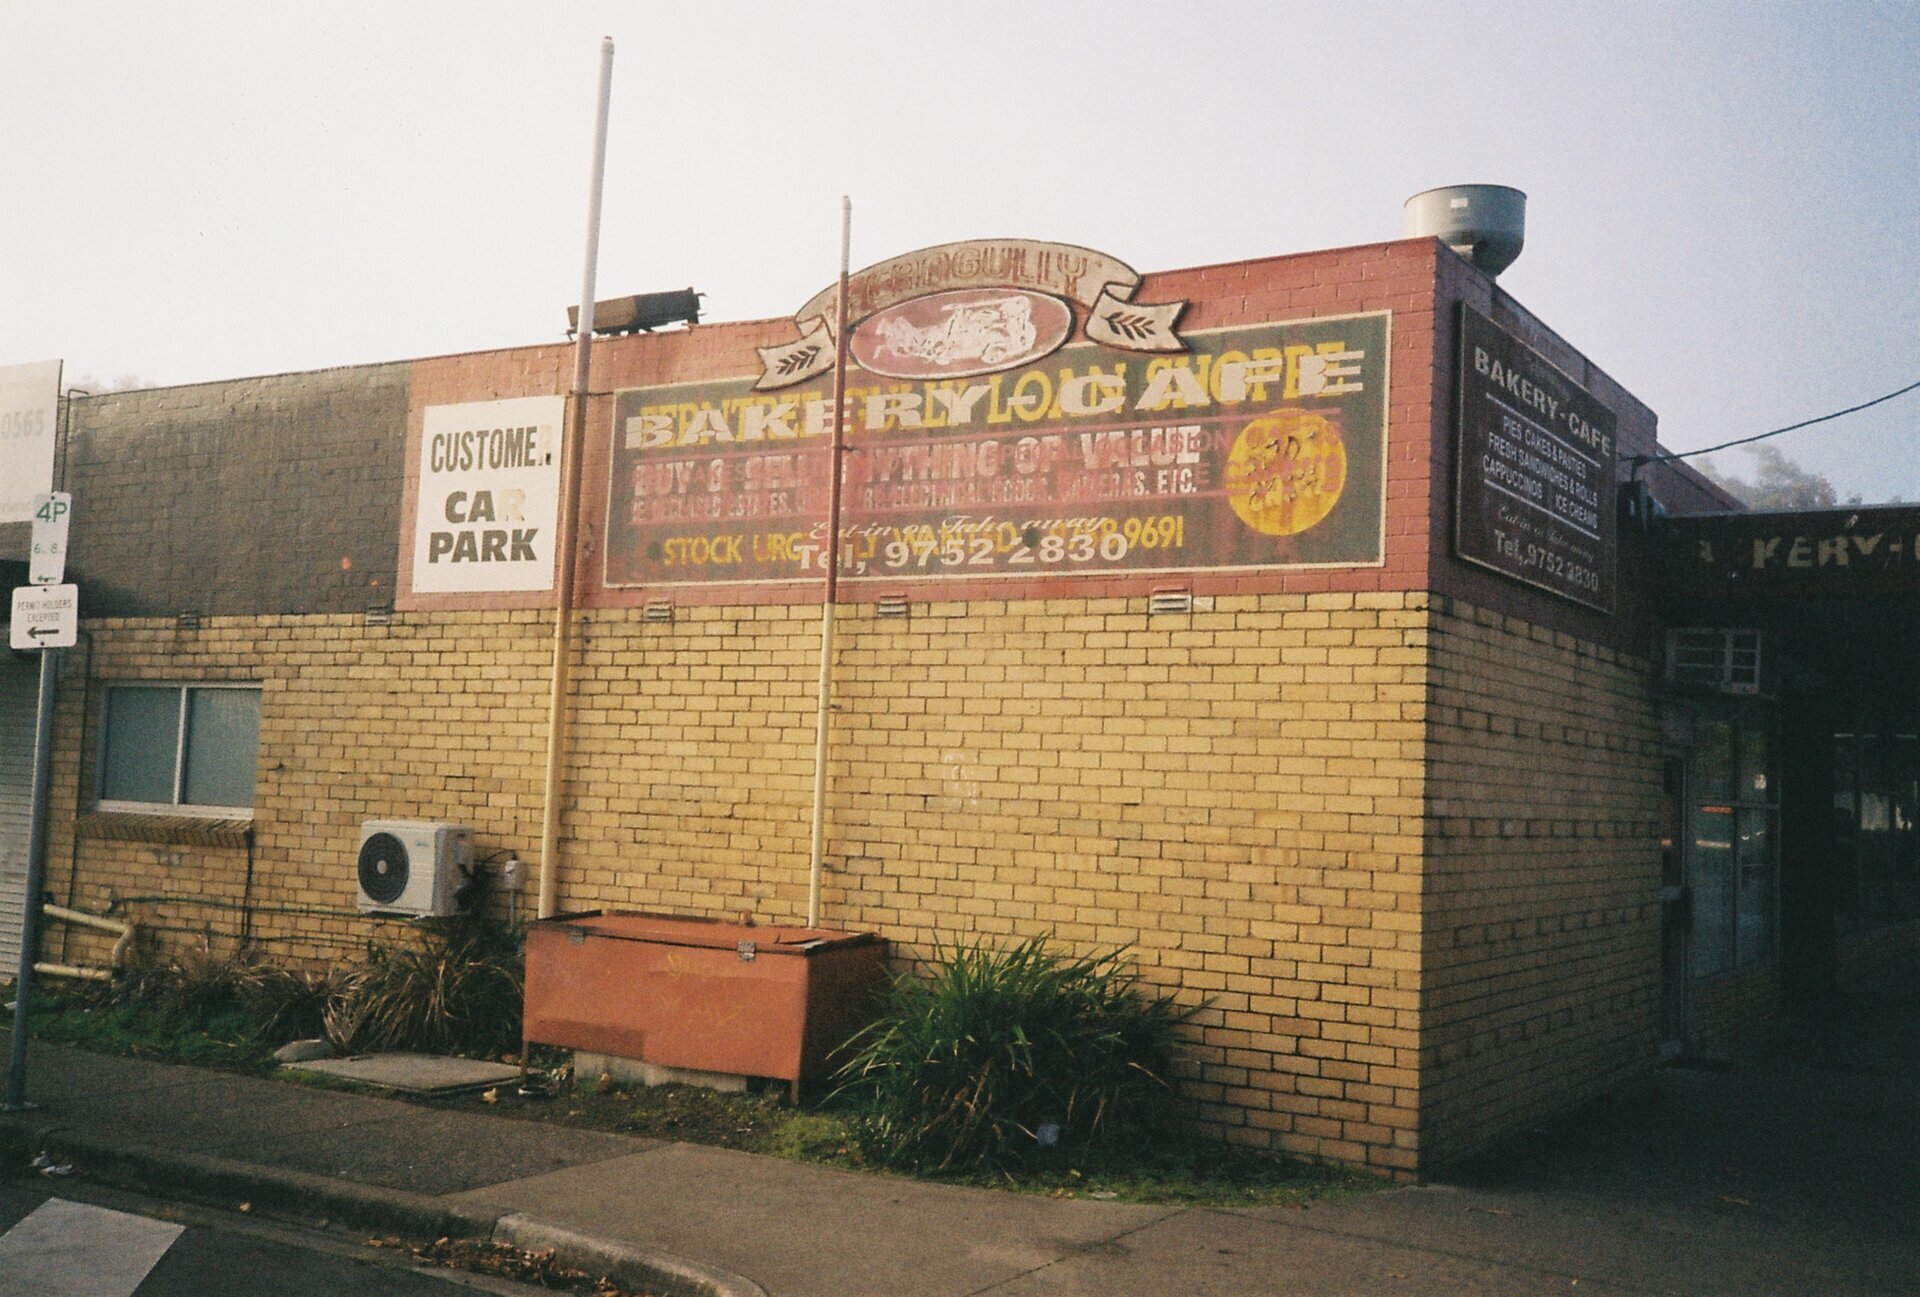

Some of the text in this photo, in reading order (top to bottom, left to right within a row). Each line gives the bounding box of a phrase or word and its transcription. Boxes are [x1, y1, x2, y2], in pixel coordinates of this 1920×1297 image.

[625, 383, 991, 449] BAKERY
[1060, 350, 1364, 414] CAFE
[431, 426, 552, 473] CUSTOME
[1568, 412, 1611, 457] CAFE
[36, 501, 67, 524] 4P
[429, 528, 538, 563] PARK
[664, 535, 744, 567] STOCK
[885, 539, 994, 568] 9752
[1008, 533, 1129, 564] 2830
